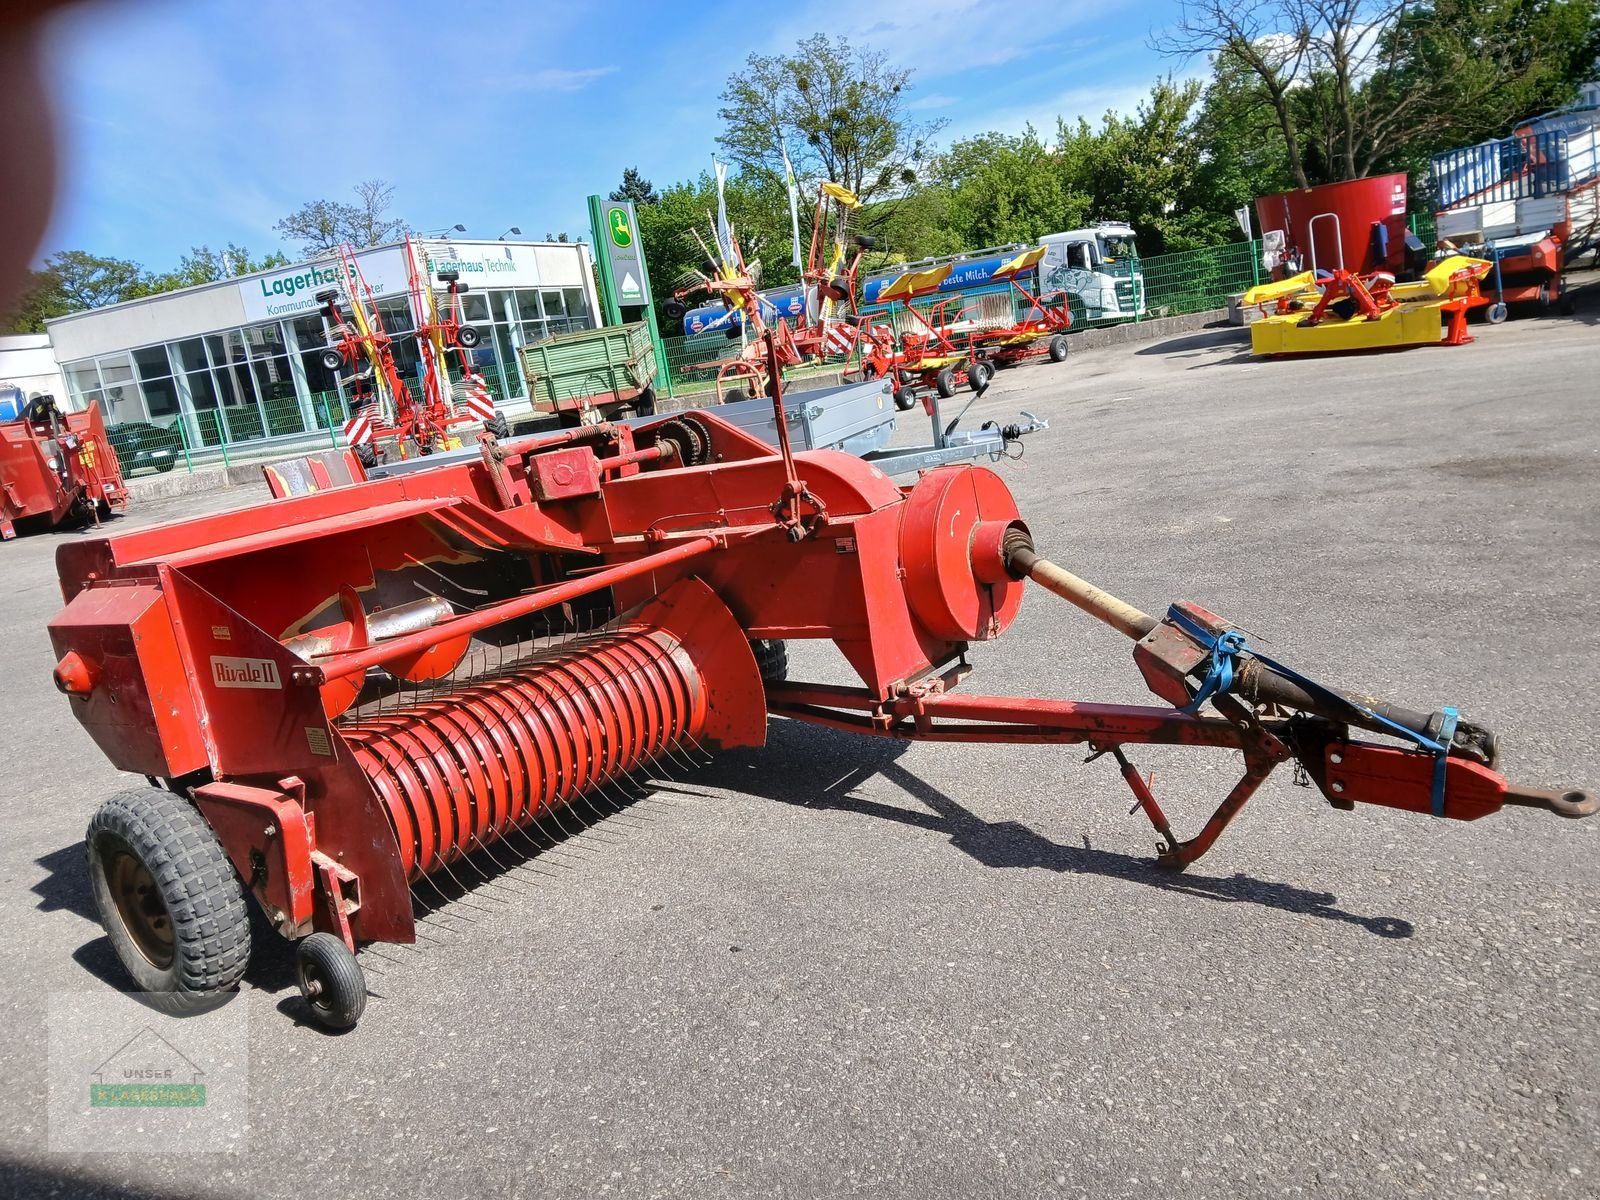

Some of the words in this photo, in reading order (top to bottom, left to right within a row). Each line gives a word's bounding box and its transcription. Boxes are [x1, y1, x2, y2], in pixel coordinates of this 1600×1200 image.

[485, 258, 516, 272] Technik
[965, 268, 990, 281] Milch.
[214, 662, 261, 683] Rivale
[261, 662, 275, 683] II
